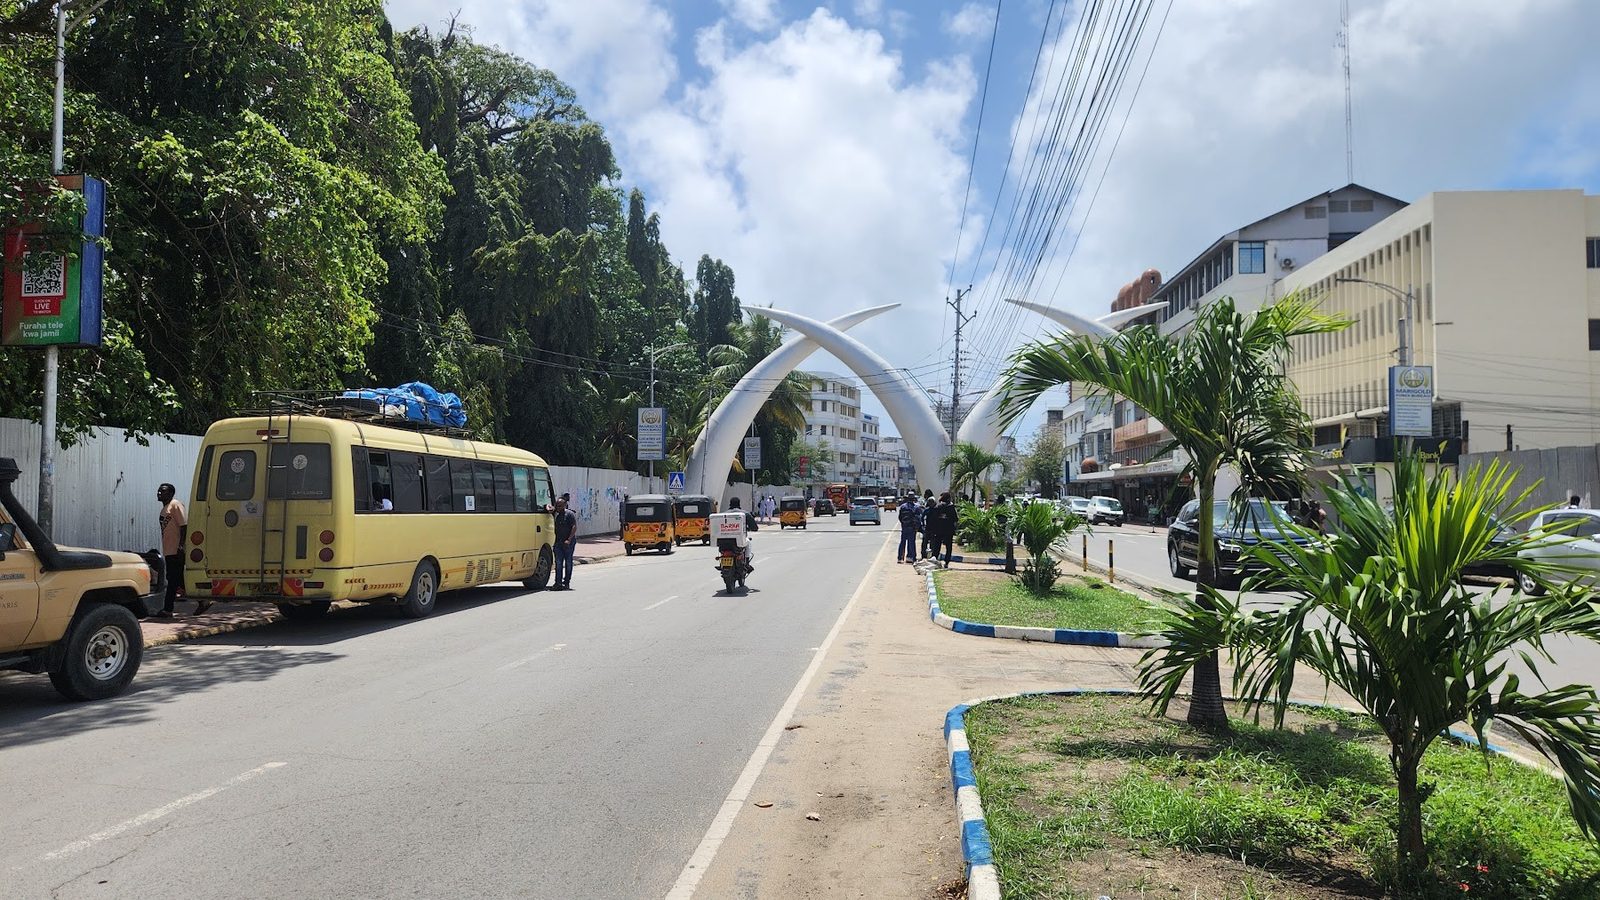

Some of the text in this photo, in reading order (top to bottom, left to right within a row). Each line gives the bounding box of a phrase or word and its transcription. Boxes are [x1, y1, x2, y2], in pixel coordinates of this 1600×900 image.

[19, 321, 64, 330] Furaha tele
[22, 329, 60, 339] kwa jamii
[1420, 451, 1440, 460] Bank
